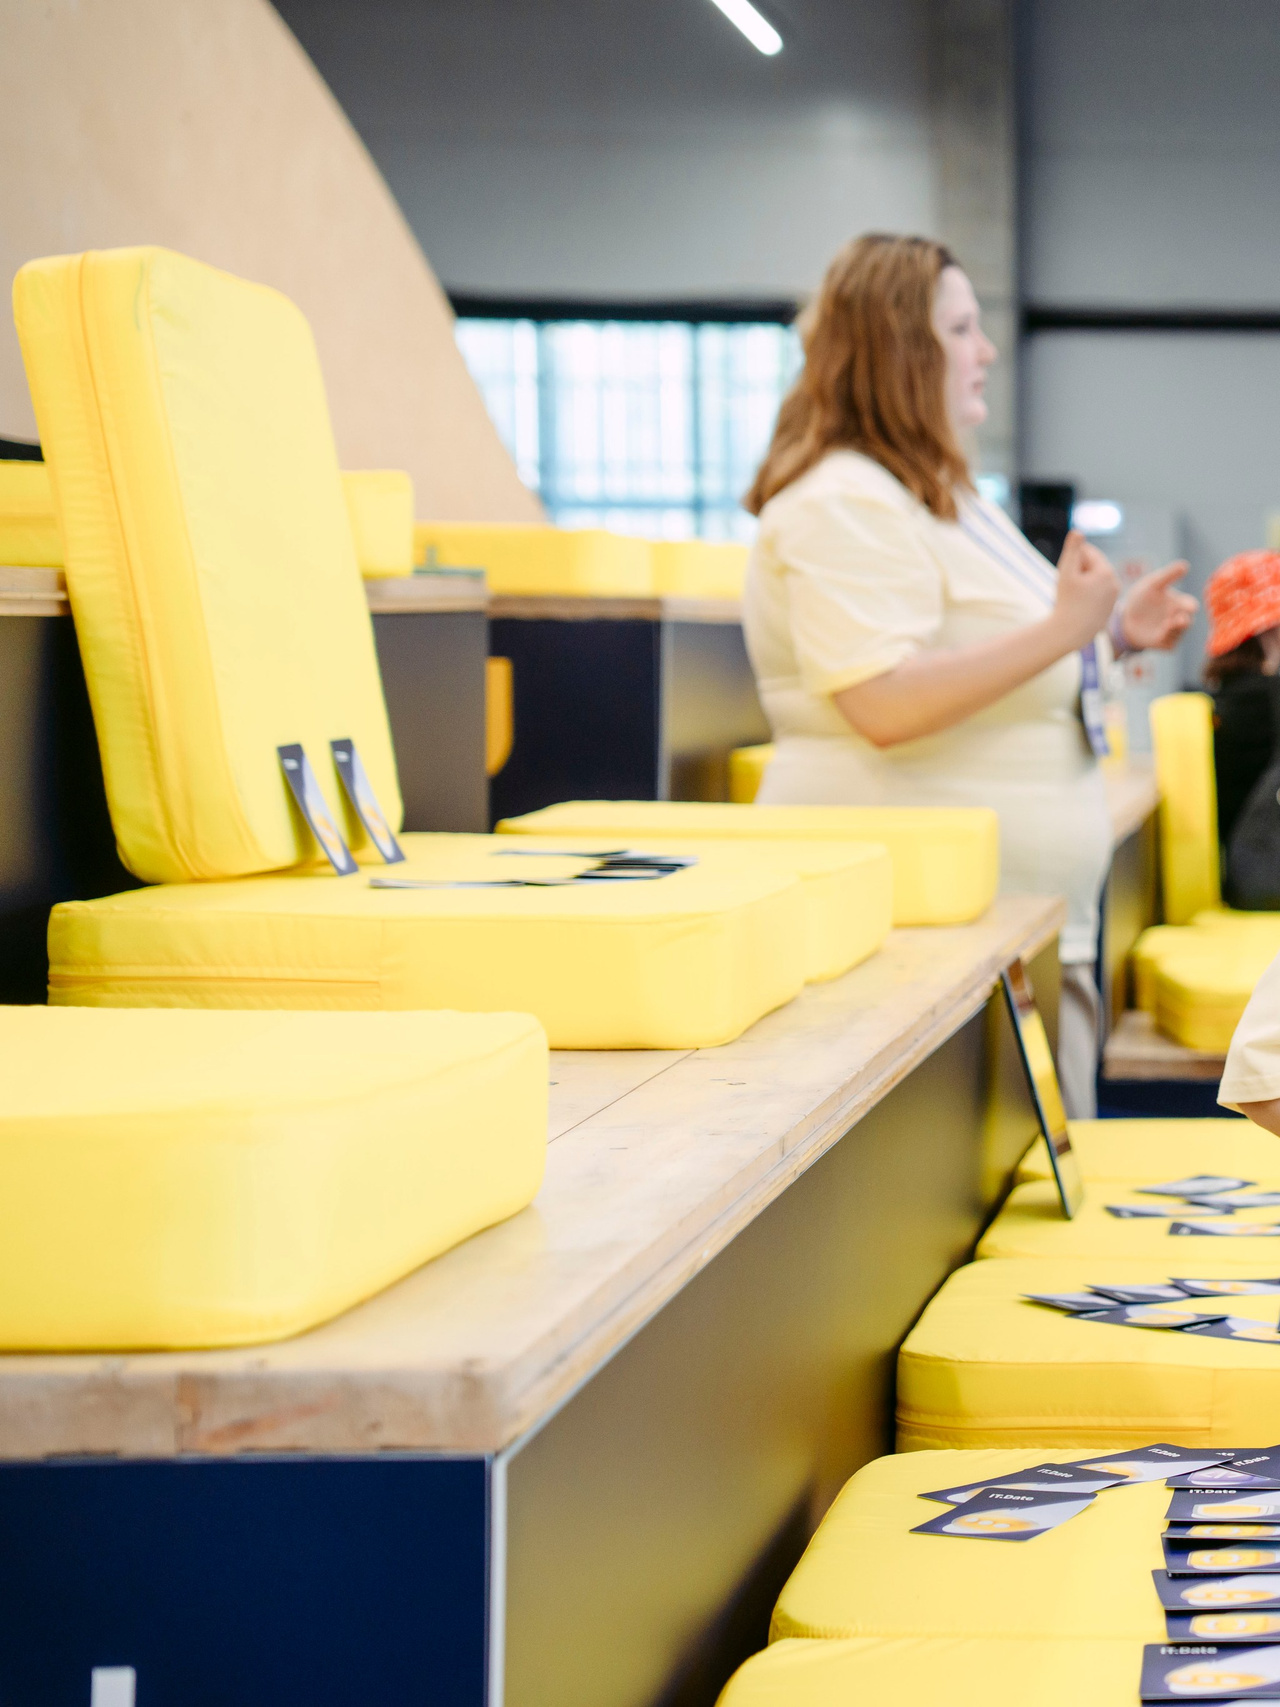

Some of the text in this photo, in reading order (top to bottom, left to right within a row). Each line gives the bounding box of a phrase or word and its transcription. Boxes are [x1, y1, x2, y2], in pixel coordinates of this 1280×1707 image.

[1232, 1455, 1271, 1467] IT.Date
[1036, 1468, 1074, 1478] IT.Date
[988, 1493, 1035, 1501] IT.Date
